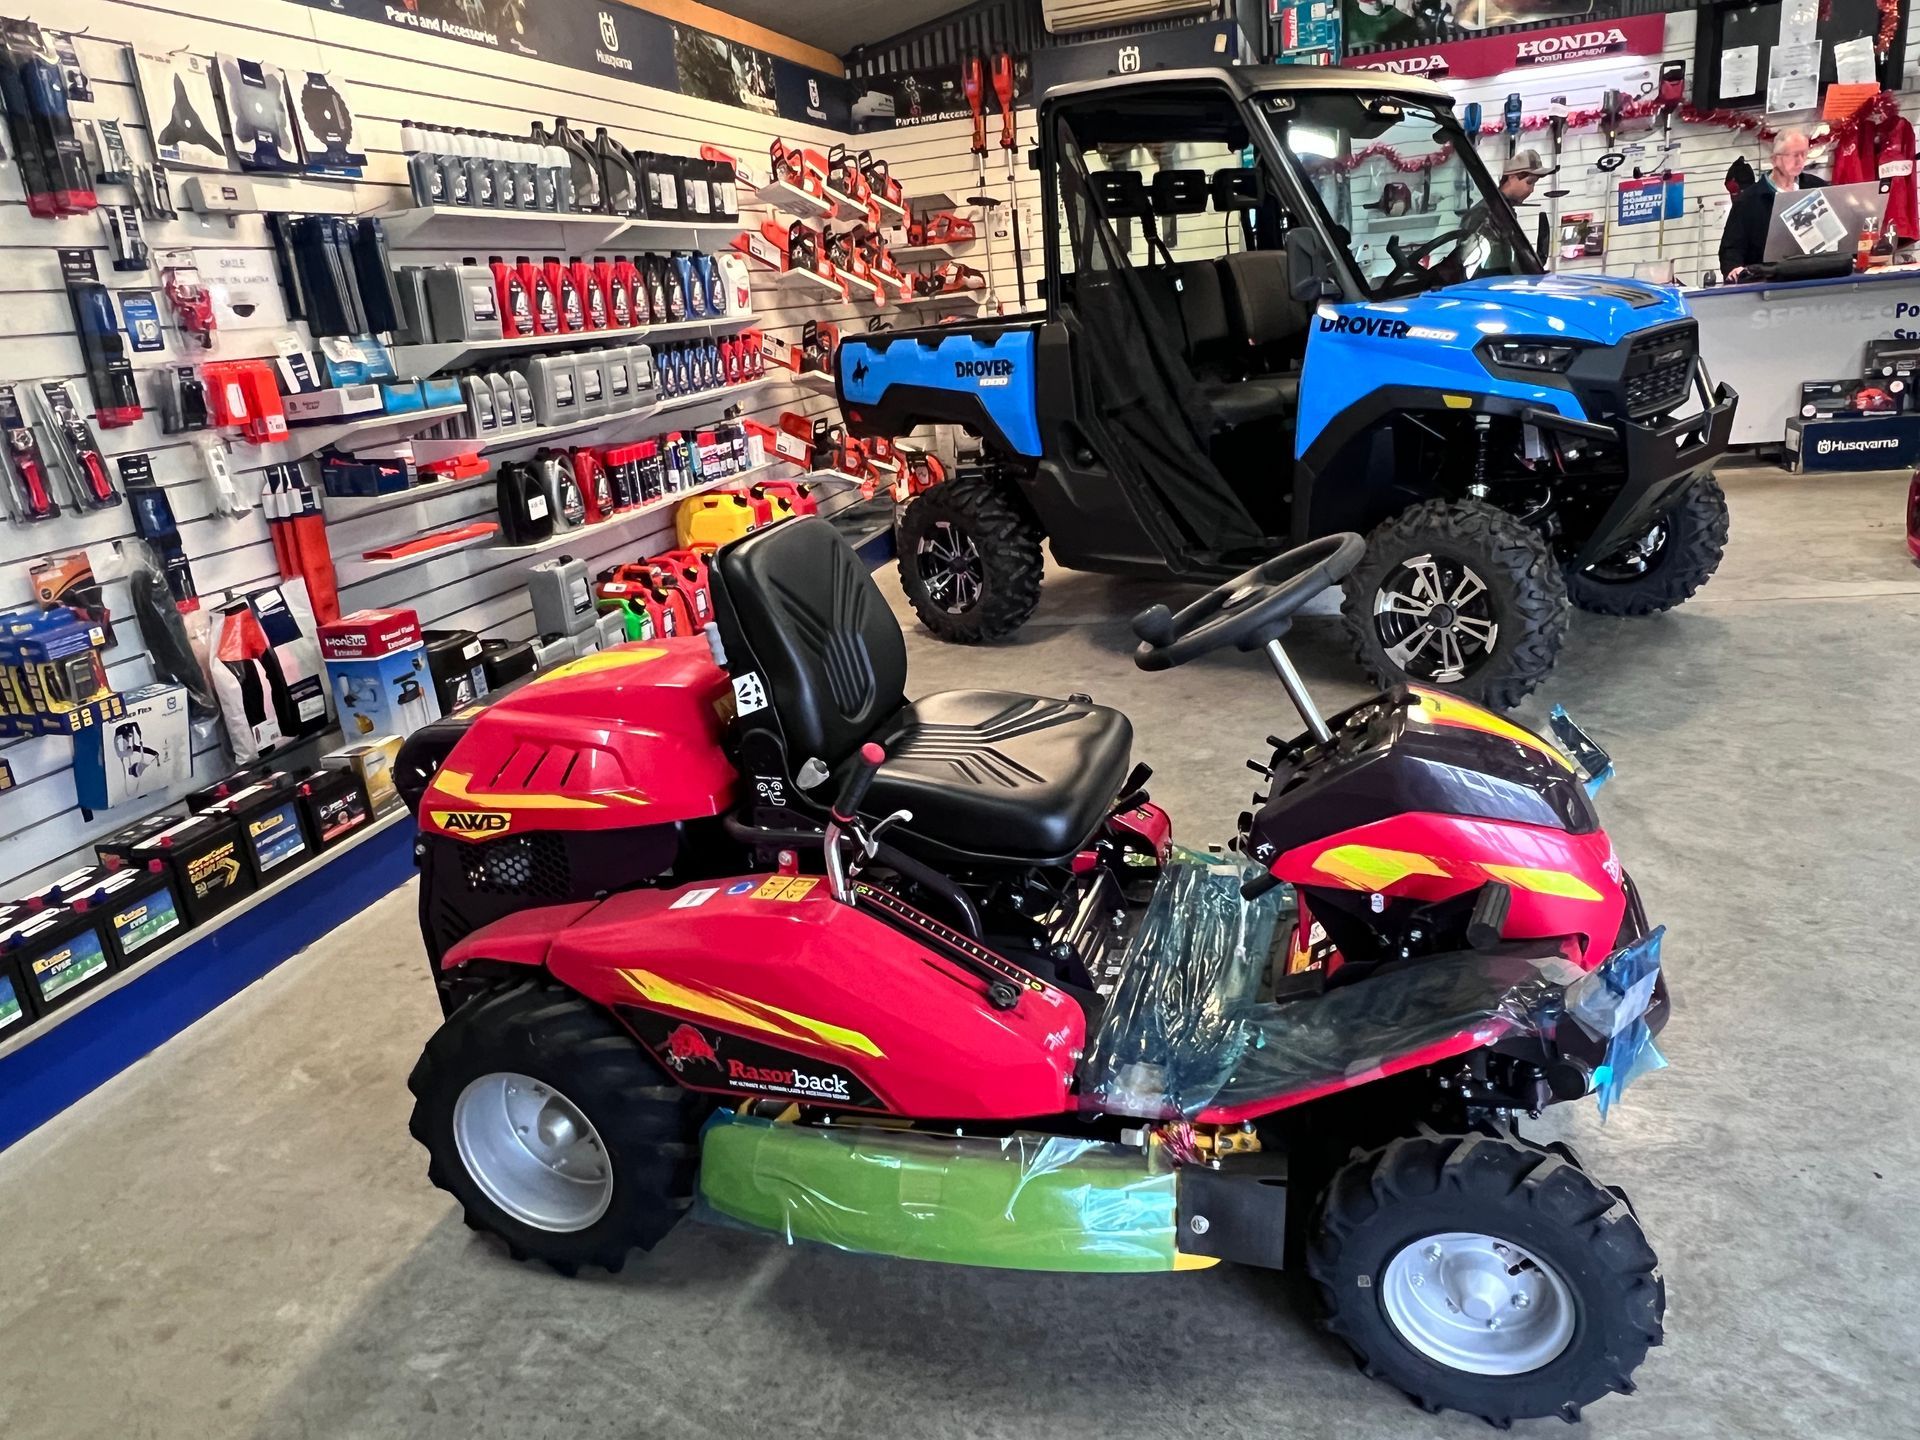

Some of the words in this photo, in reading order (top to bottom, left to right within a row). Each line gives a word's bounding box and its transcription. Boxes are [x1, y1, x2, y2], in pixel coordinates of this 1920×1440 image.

[384, 5, 418, 27] Parts
[419, 15, 440, 32] and
[441, 20, 499, 46] Accessories
[1516, 28, 1628, 58] HONDA
[595, 48, 633, 71] Husqvarna
[1534, 53, 1563, 63] POWER
[1564, 46, 1607, 59] EQUIPMENT
[1355, 54, 1450, 74] NDA
[895, 116, 919, 127] Parts
[920, 114, 938, 124] and
[938, 106, 988, 121] Accesso
[1622, 189, 1644, 199] NEW
[1622, 193, 1662, 205] DOMESTI
[1622, 200, 1663, 212] BATTERY
[1622, 208, 1653, 218] RANGE
[1319, 315, 1409, 339] DROVER
[1406, 326, 1458, 341] 1000
[955, 359, 1012, 378] DROVER
[1831, 438, 1899, 451] Husqvarna
[443, 813, 508, 831] AWD
